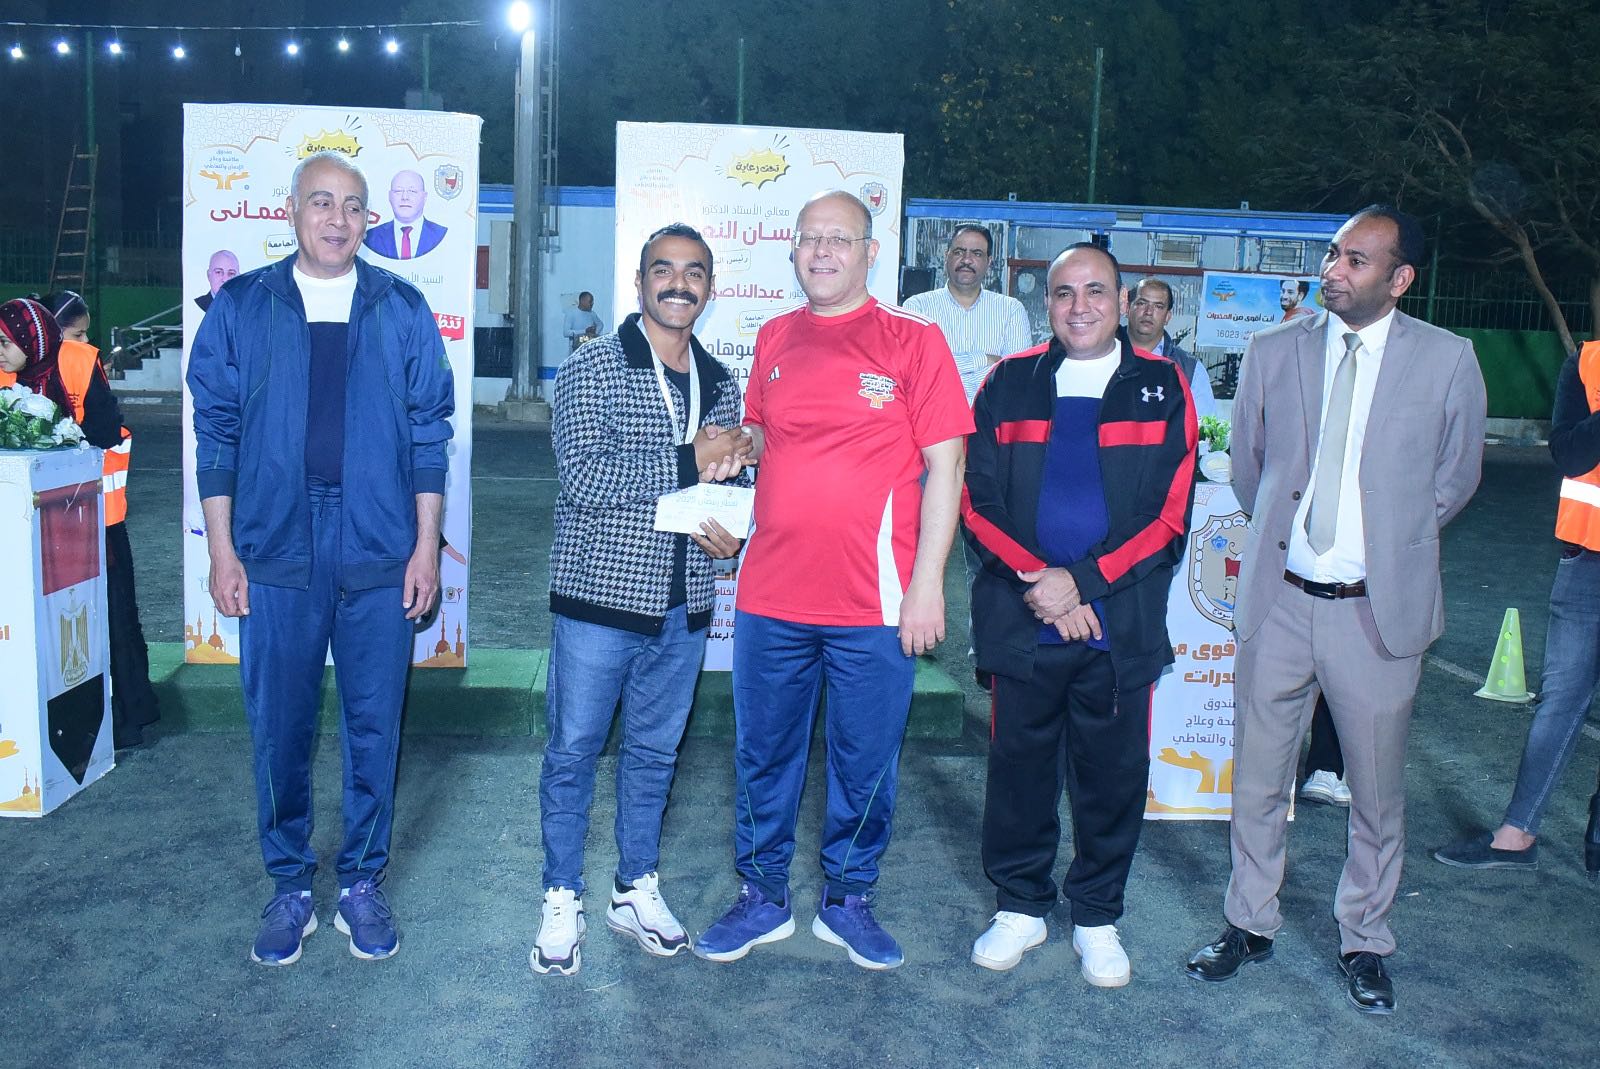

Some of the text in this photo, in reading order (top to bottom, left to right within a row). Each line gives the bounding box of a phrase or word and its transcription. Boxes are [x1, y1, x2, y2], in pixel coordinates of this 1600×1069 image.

[736, 161, 780, 174] تحت رعاية
[271, 185, 289, 197] كتور
[210, 200, 288, 222] عمانى
[743, 221, 794, 246] سان
[267, 238, 297, 249] الجامعة
[788, 288, 808, 300] كتور
[438, 313, 462, 330] تنظ
[1216, 328, 1240, 339] 16023
[1192, 639, 1236, 661] قوى
[1184, 669, 1236, 688] درات
[1186, 715, 1214, 728] وعلاج
[1173, 733, 1226, 747] والتعاطي
